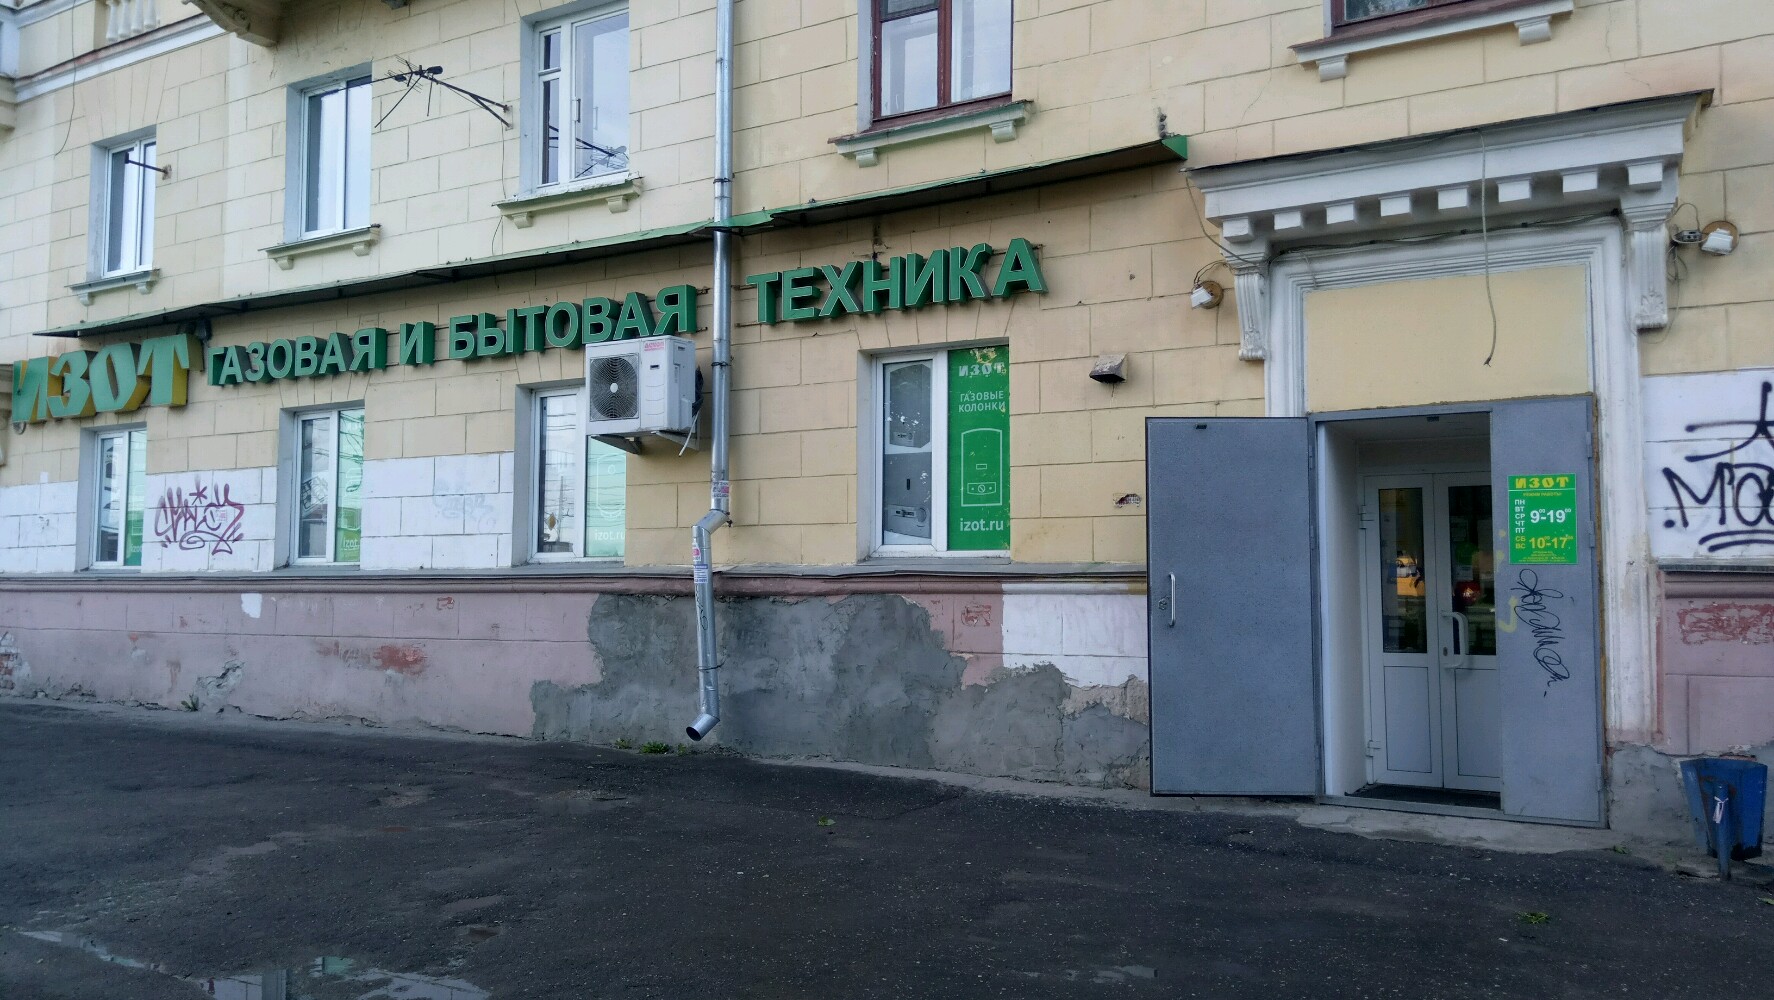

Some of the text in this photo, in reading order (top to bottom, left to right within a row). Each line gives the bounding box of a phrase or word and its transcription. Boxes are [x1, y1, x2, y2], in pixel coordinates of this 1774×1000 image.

[207, 237, 1048, 387] ГАЗОВАЯ И БЫТОВАЯ ТЕХНИКА
[958, 362, 1006, 377] ИЗОТ
[12, 333, 196, 424] ИЗОТ
[960, 391, 1004, 402] ГАЗОВЫЕ
[958, 401, 1006, 413] КОЛОНКИ
[1515, 476, 1569, 489] ИЗОТ
[960, 517, 1004, 531] izot.ru
